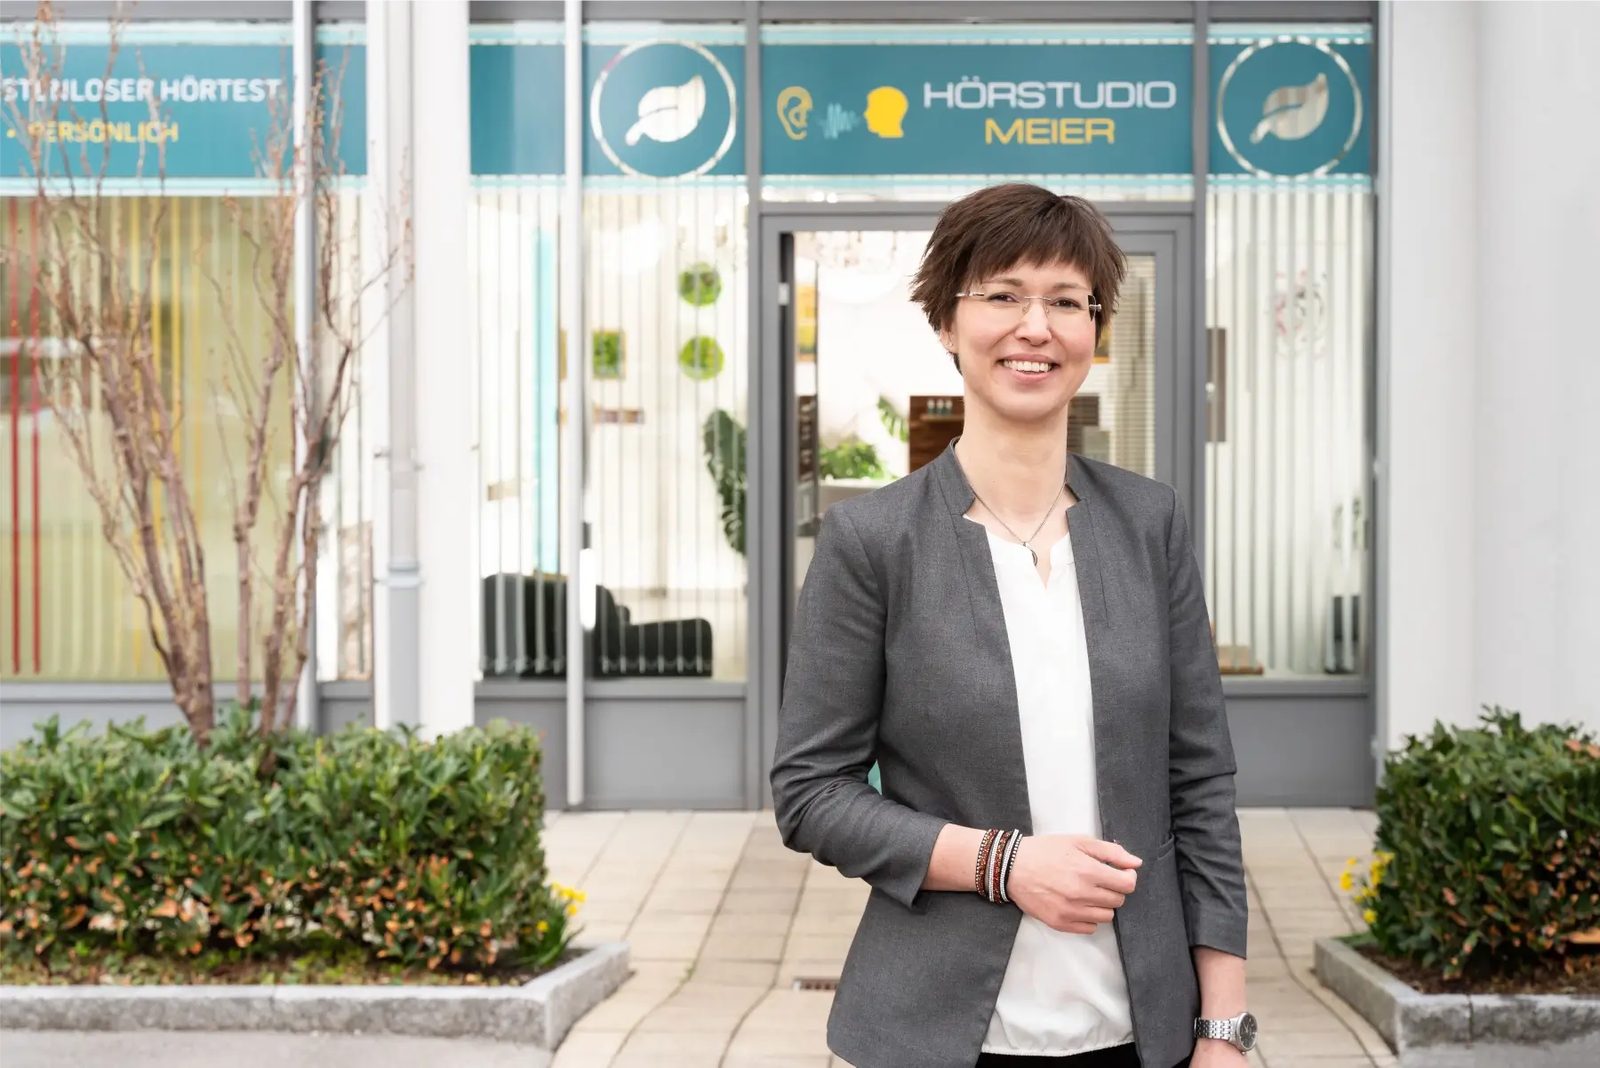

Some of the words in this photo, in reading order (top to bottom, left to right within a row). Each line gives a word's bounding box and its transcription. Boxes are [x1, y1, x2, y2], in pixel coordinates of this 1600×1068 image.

[160, 76, 281, 102] HÖRTEST
[924, 76, 1177, 109] HÖRSTUDIO
[984, 118, 1115, 144] MEIER
